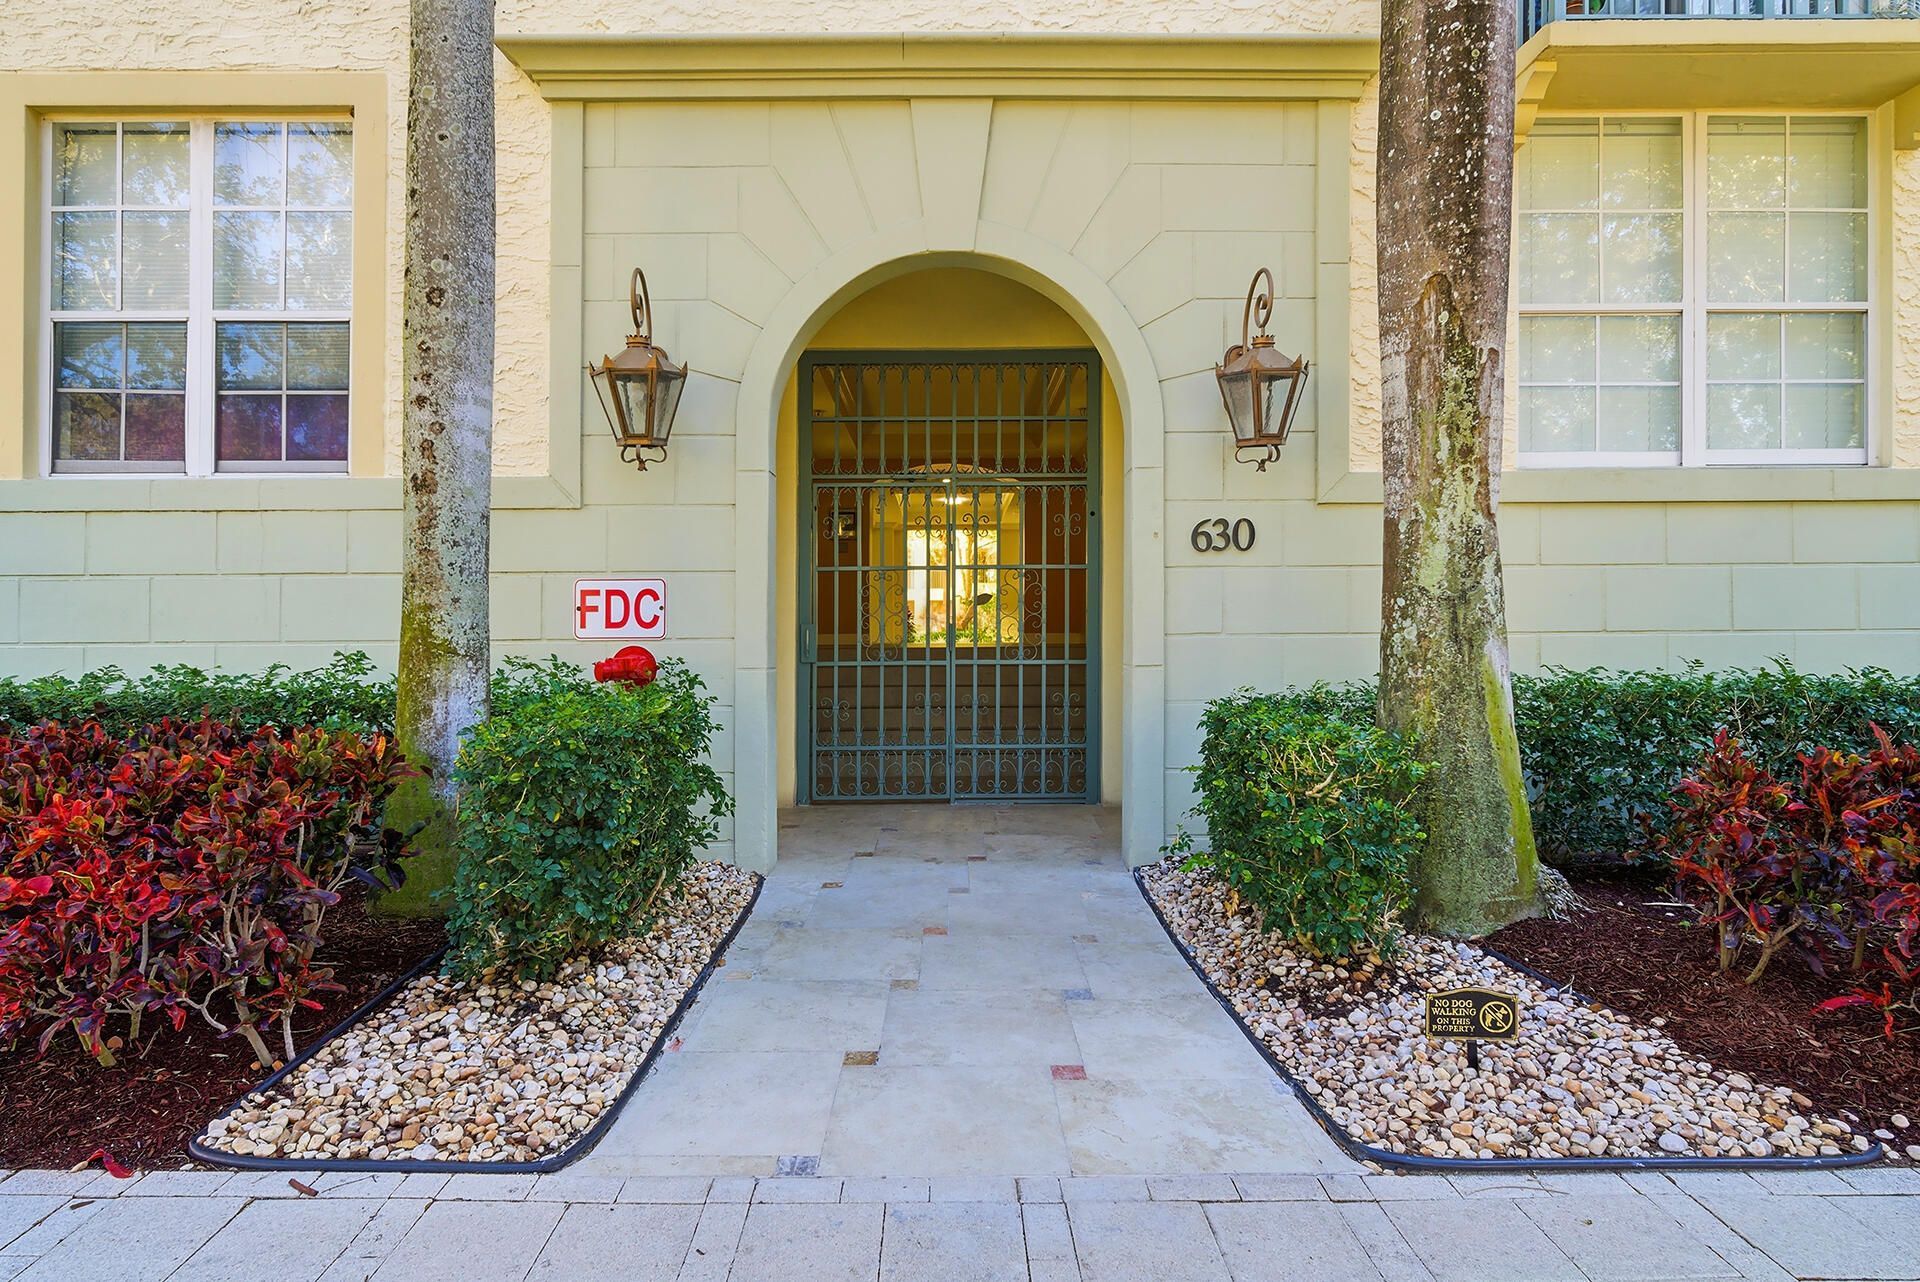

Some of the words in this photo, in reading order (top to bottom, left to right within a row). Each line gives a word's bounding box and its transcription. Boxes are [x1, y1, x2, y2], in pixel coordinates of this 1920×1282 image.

[1191, 518, 1256, 552] 630
[580, 588, 660, 630] FDC
[1434, 999, 1449, 1008] NO
[1451, 999, 1473, 1008] DOG
[1431, 1008, 1477, 1016] WALKING
[1436, 1017, 1449, 1025] ON
[1451, 1017, 1471, 1025] THIS
